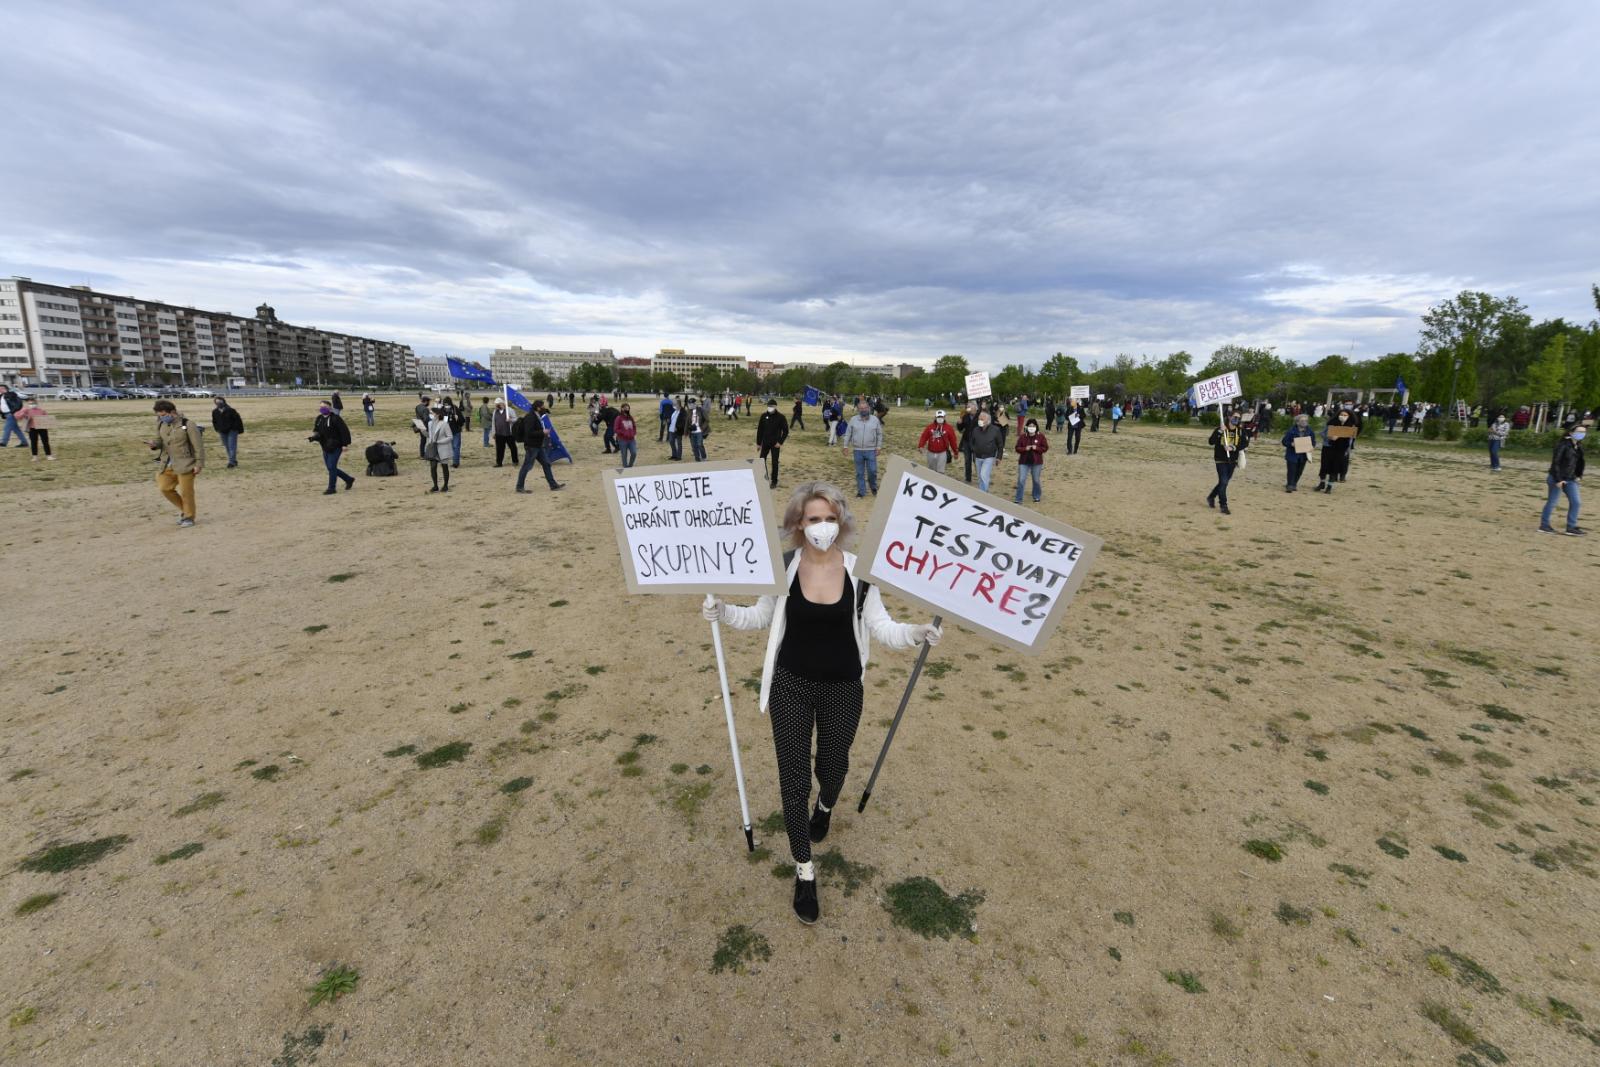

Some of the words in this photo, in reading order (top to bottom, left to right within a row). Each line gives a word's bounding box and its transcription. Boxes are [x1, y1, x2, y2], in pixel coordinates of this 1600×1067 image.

[1199, 376, 1232, 394] BUDETE
[617, 483, 650, 505] JAK
[654, 476, 713, 502] BUDETE
[625, 505, 681, 530] CHRÁNIT
[684, 500, 753, 528] OHROŽENÉ
[902, 478, 958, 509] KDY
[964, 505, 1083, 562] ZAČNETE
[638, 537, 758, 578] SKUPINY?
[914, 515, 1067, 588] TESTOVAT
[885, 540, 1051, 626] CHYTŘE?
